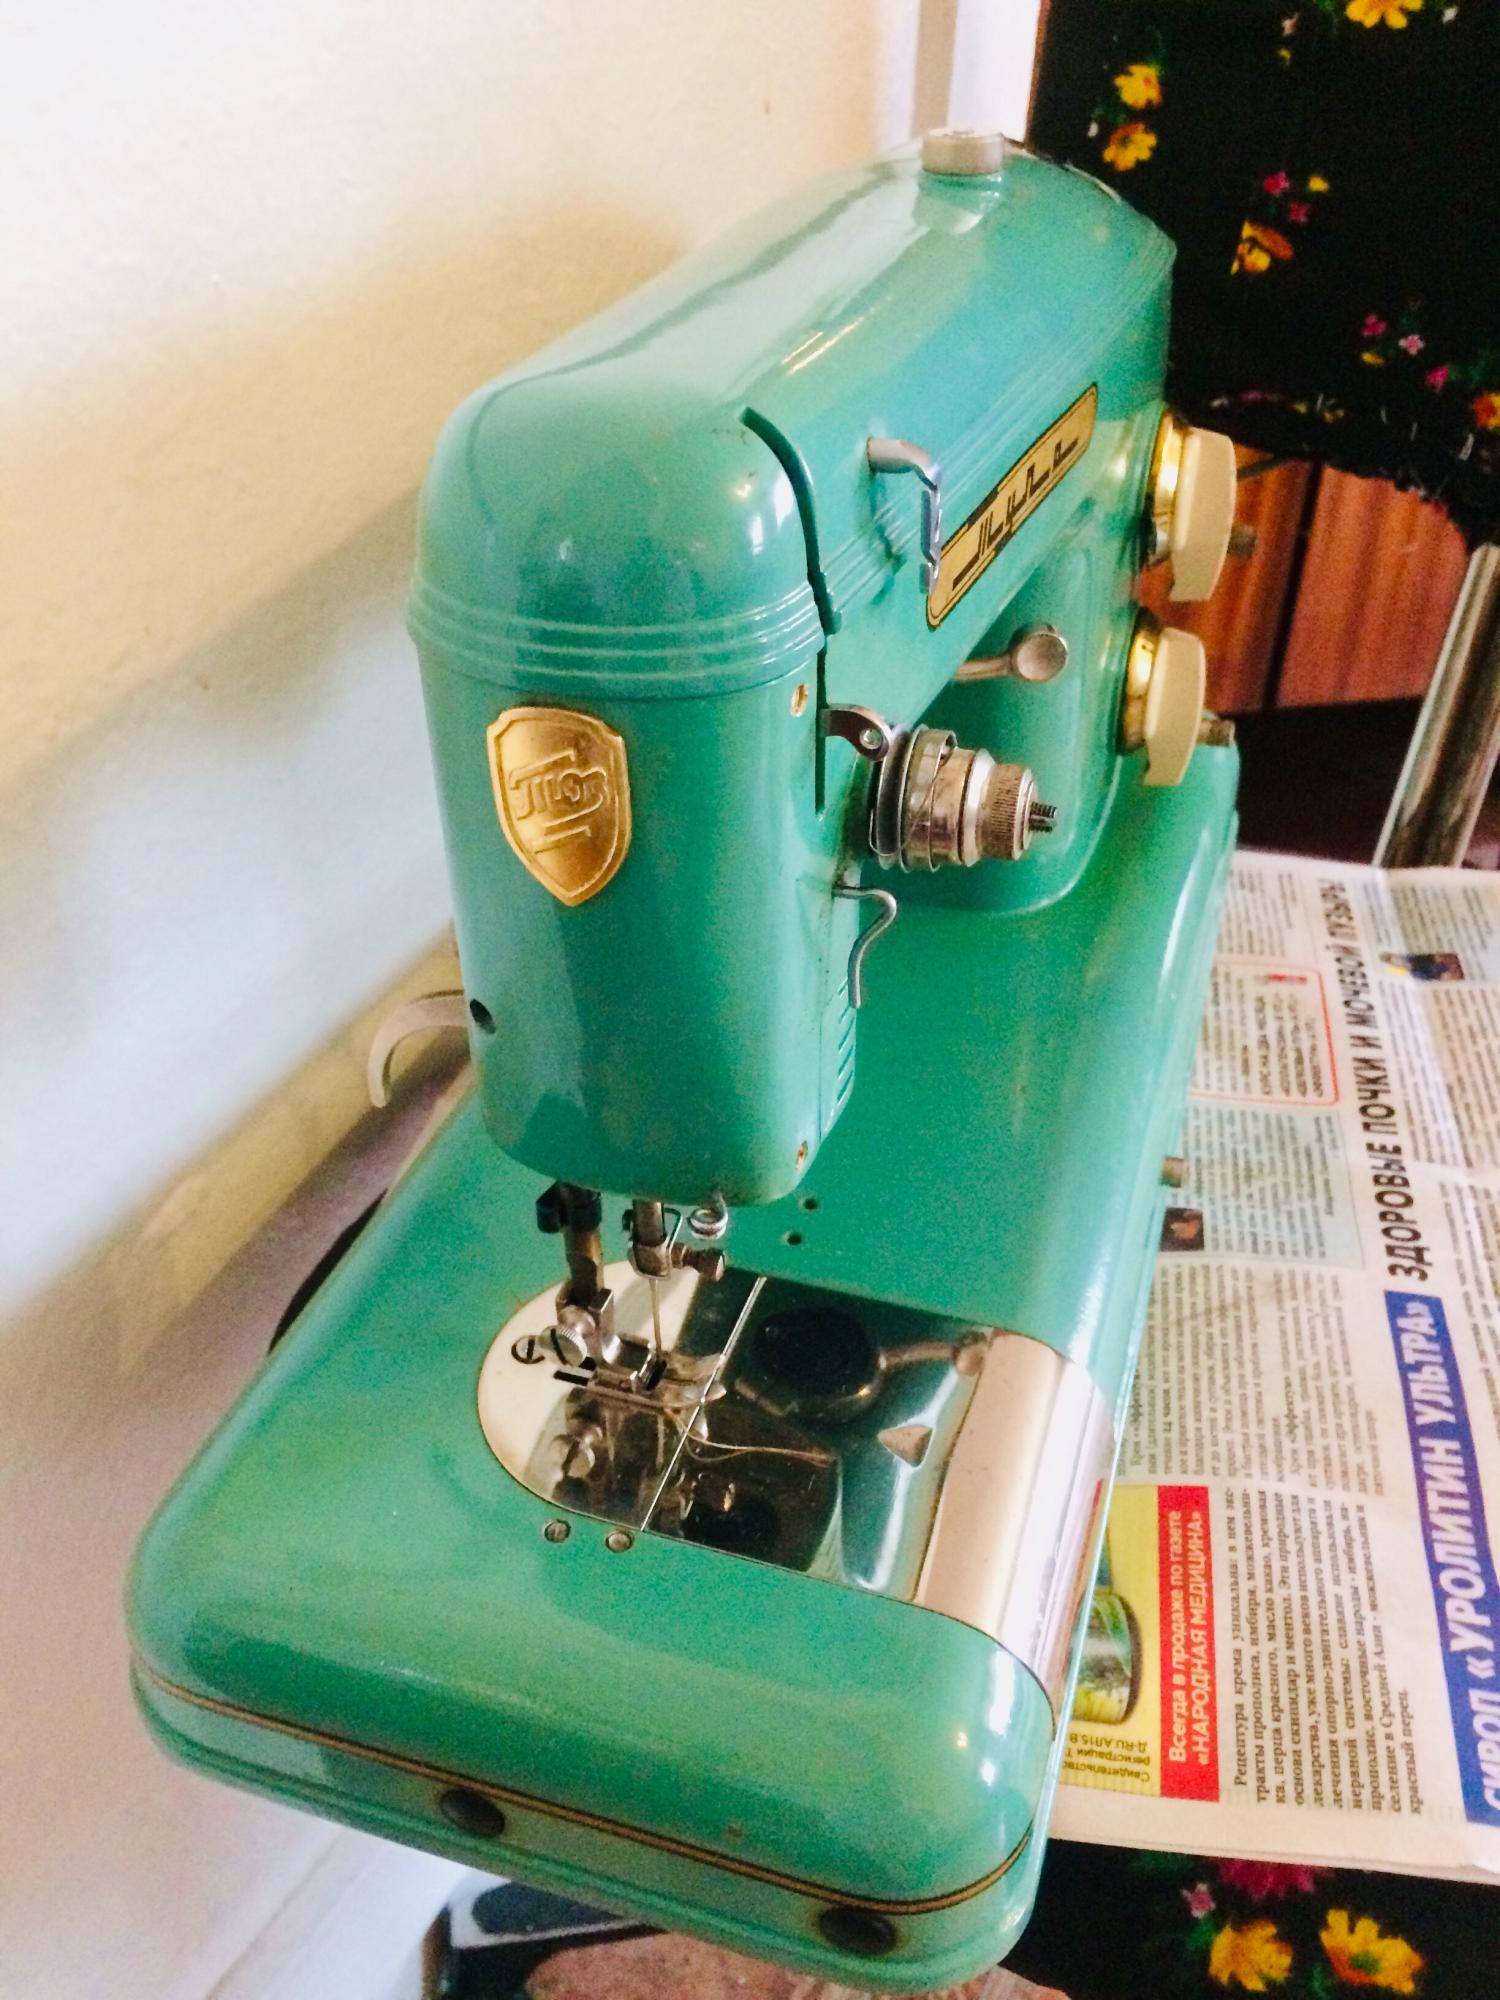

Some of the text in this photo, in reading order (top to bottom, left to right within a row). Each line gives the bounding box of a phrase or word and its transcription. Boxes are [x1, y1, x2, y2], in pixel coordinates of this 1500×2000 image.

[1325, 943, 1378, 1029] МОЧЕВОЙ
[1350, 1035, 1382, 1048] И
[1351, 1057, 1398, 1136] ПОЧКИ
[1365, 1142, 1432, 1282] ЗДОРОВЫЕ
[1396, 1302, 1457, 1425] УЛЬТРА»
[1226, 1516, 1236, 1539] нем
[1257, 1490, 1273, 1548] кремовая
[1274, 1492, 1291, 1562] природные
[1262, 1552, 1274, 1593] какао,
[1279, 1566, 1290, 1590] Эти
[1358, 1516, 1378, 1612] можжевельник
[1418, 1437, 1495, 1679] «УРОЛИТИН
[1229, 1559, 1244, 1641] уникальна:
[1265, 1598, 1276, 1642] масло
[1282, 1594, 1295, 1651] ментол.
[1350, 1586, 1366, 1636] народы
[1168, 1511, 1189, 1762] Всегда в продаже по газете
[1187, 1511, 1211, 1765] «НАРОДНАЯ МЕДИЦИНА»
[1232, 1648, 1246, 1695] крема
[1242, 1488, 1270, 1803] тракты прополиса, имбиря, можжевельни-
[1286, 1655, 1296, 1665] и
[1290, 1494, 1325, 1808] лекарства, уже много веков используют для
[1314, 1567, 1339, 1734] опорно-двигательного
[1323, 1500, 1364, 1808] нервной системы: славяне использовали
[1372, 1625, 1385, 1660] Азии
[1268, 1648, 1284, 1722] красного,
[1286, 1668, 1300, 1745] скипидар
[1357, 1640, 1373, 1722] восточные
[1373, 1663, 1395, 1728] Средней
[1077, 1749, 1151, 1766] регистрации
[1233, 1703, 1248, 1786] Рецептура
[1272, 1727, 1286, 1775] перца
[1365, 1726, 1384, 1811] прополис,
[1384, 1733, 1394, 1741] в
[1398, 1689, 1424, 1814] красный перец.
[1275, 1780, 1286, 1804] ка,
[1291, 1750, 1305, 1806] основа
[1328, 1739, 1343, 1808] лечения
[1385, 1745, 1401, 1813] селение
